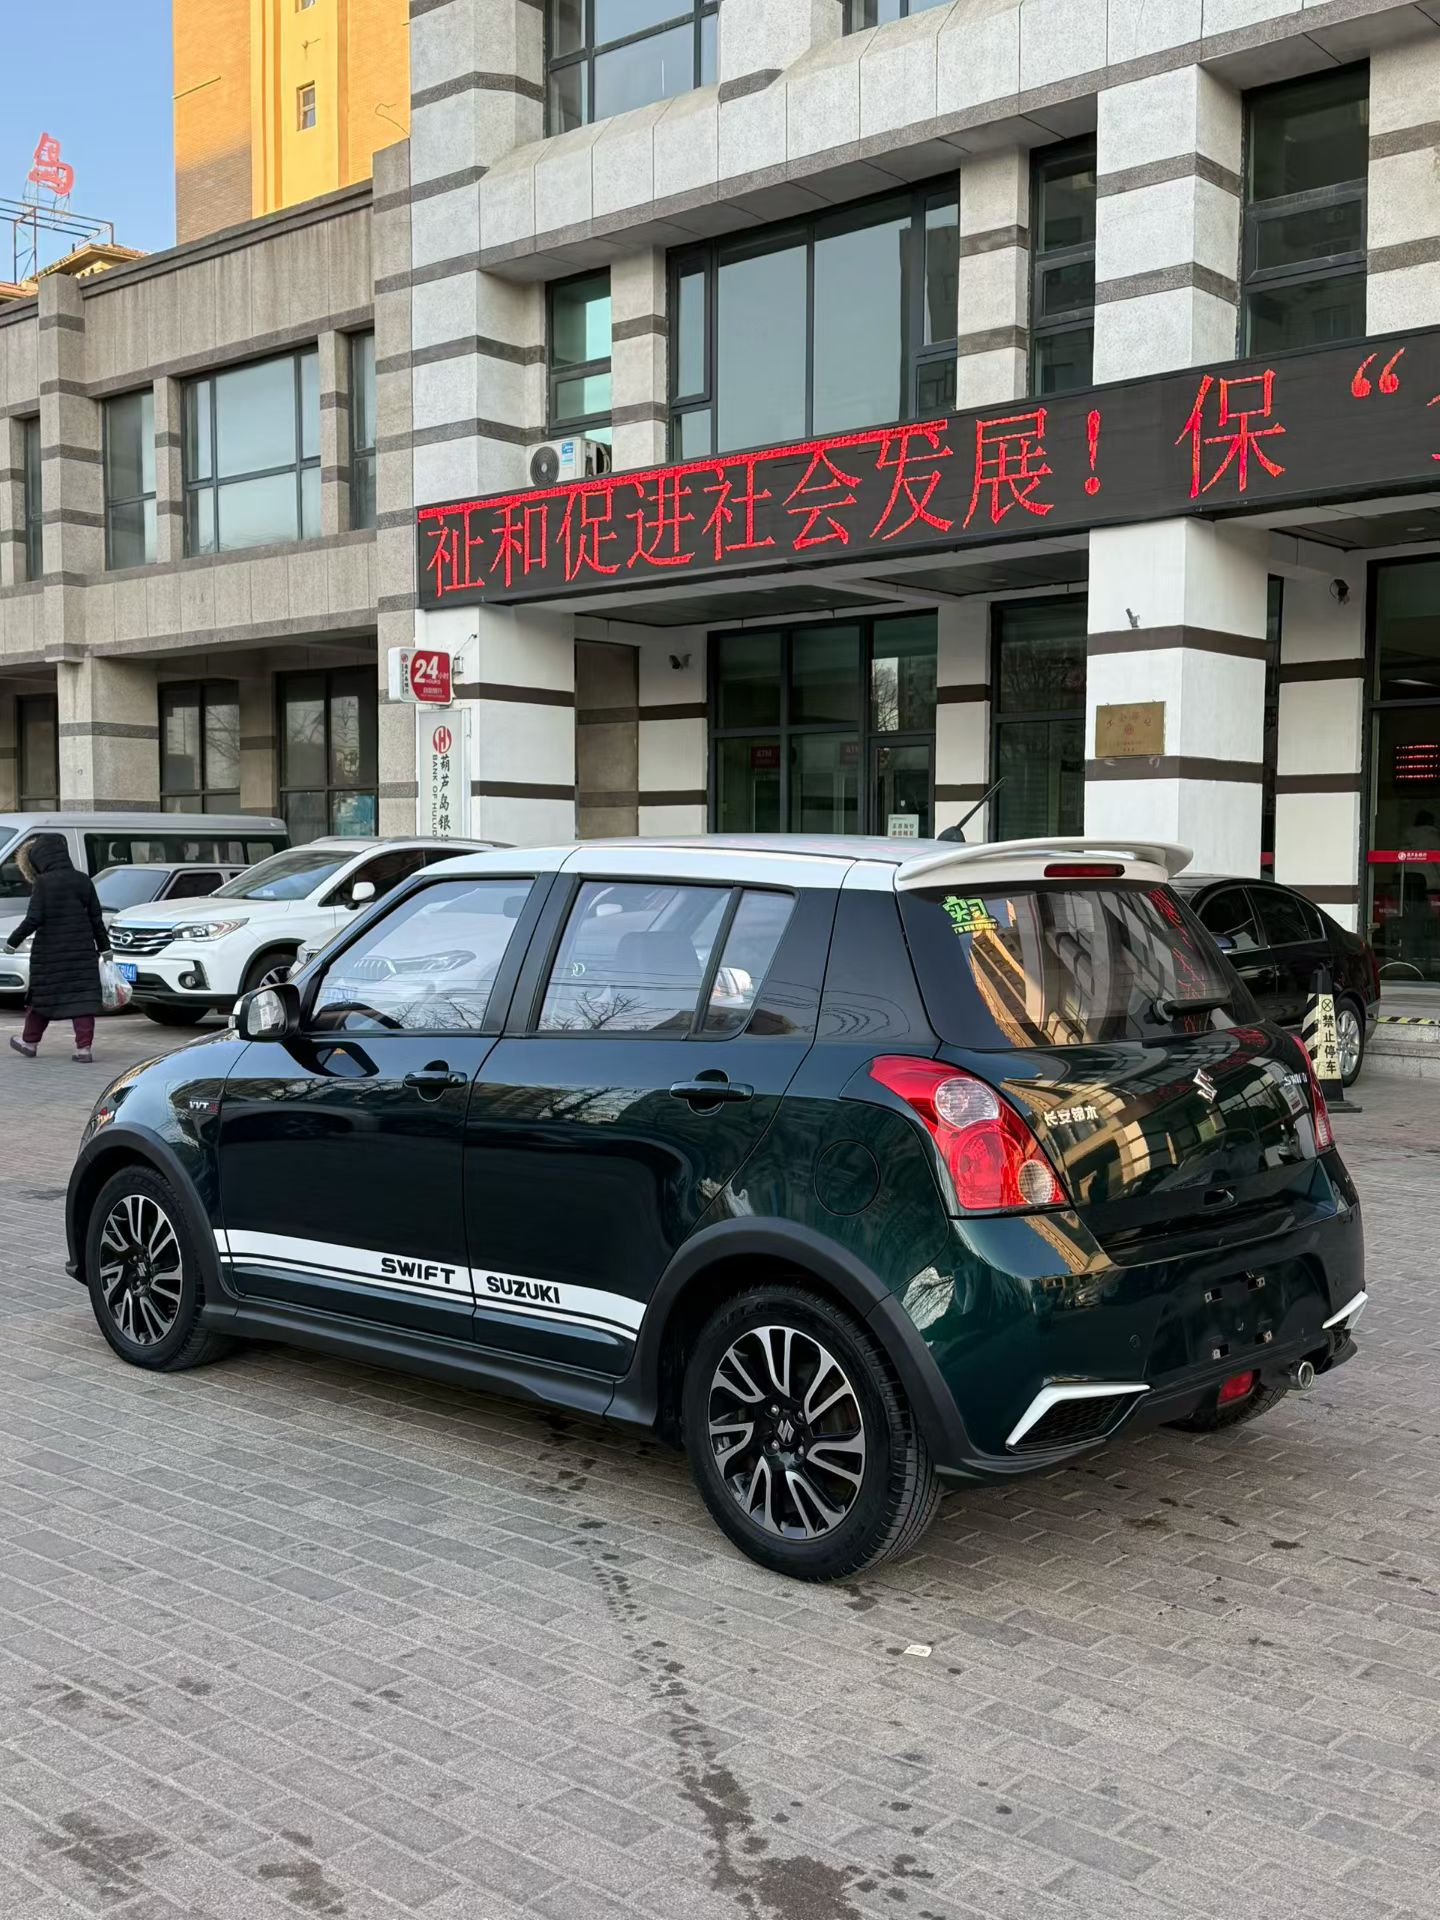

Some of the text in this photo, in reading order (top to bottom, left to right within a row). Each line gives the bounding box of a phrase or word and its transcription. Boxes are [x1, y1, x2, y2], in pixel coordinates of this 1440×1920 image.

[414, 655, 439, 683] 24
[432, 785, 438, 799] OF
[1322, 1014, 1337, 1075] 禁止停车
[1043, 1105, 1099, 1127] 长安铃木
[381, 1257, 561, 1304] SWIFT SUZUKI
